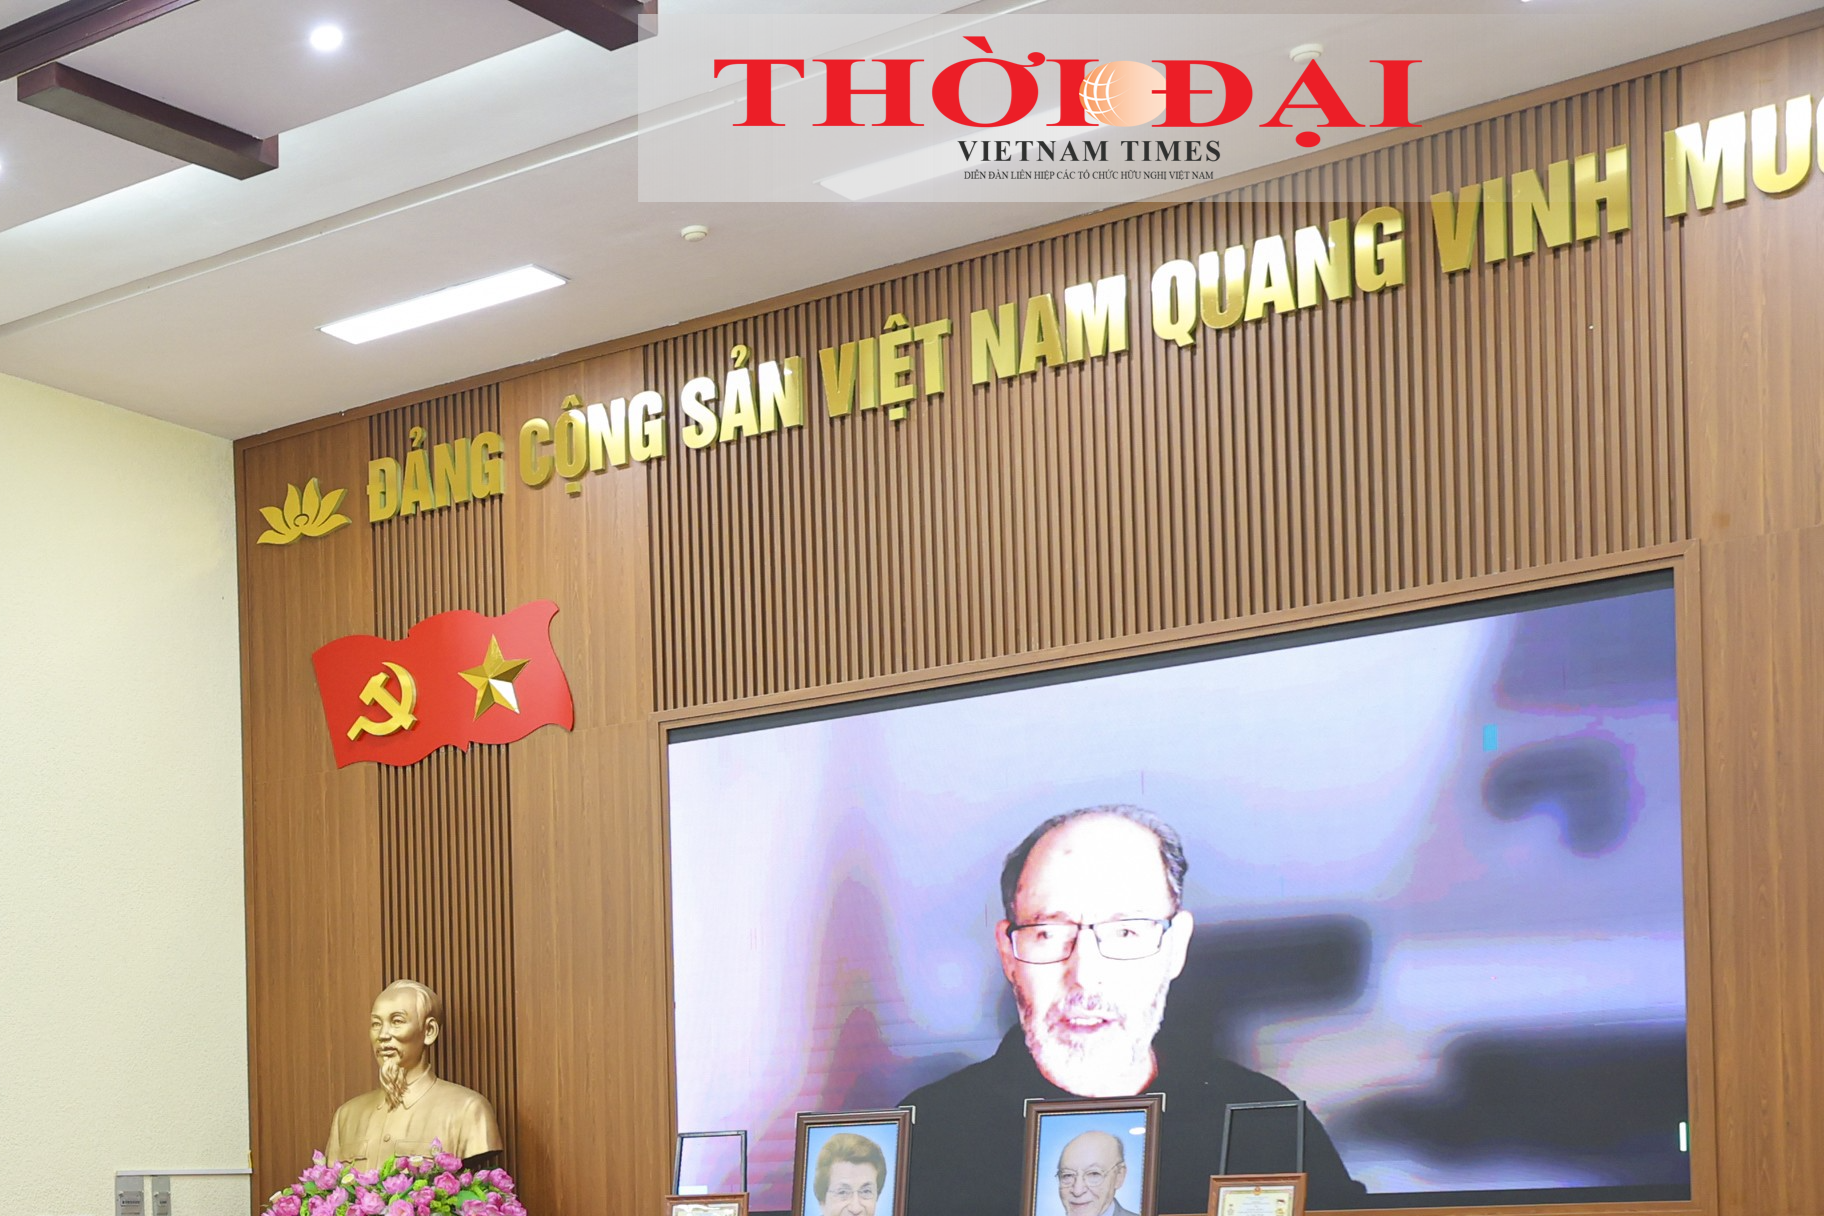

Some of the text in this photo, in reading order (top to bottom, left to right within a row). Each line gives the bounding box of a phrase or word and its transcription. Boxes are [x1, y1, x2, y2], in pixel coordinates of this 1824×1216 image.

[367, 94, 1824, 523] ĐẢNG CỘNG SẢN VIỆT NAM QUANG VINH MU
